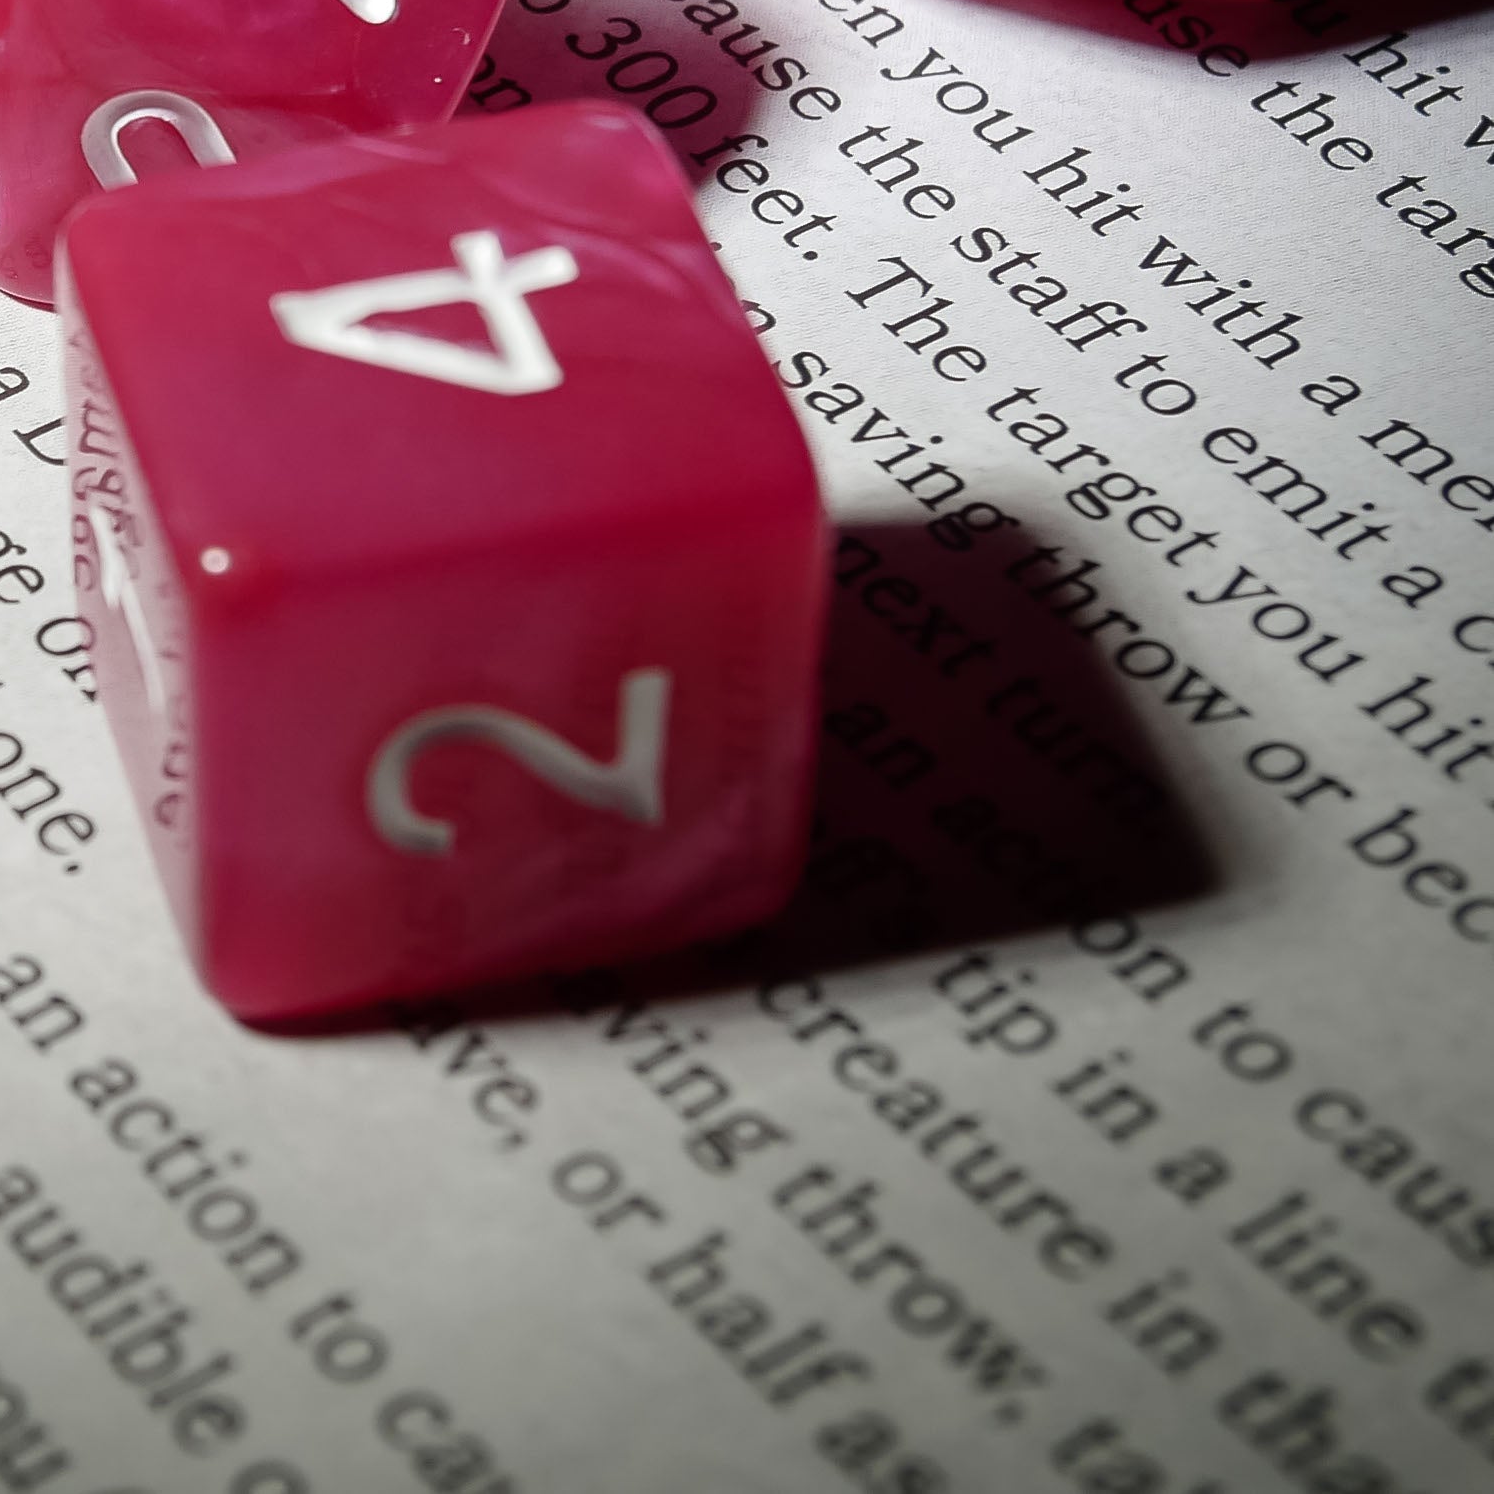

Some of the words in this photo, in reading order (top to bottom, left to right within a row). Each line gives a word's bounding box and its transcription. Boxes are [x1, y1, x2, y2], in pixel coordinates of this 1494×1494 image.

[1250, 80, 1374, 172] the
[1342, 31, 1464, 117] hit
[269, 229, 579, 396] 4
[837, 124, 956, 220] the
[951, 225, 1150, 354] staff
[1113, 351, 1198, 417] to
[1203, 425, 1393, 563] emit
[1381, 562, 1444, 609] a
[878, 46, 1035, 156] you
[1022, 145, 1143, 237] hit
[1137, 234, 1306, 371] with
[1299, 372, 1363, 418] a
[564, 16, 719, 130] 300
[691, 133, 838, 262] feet.
[845, 255, 988, 382] The
[986, 384, 1223, 569] target
[1186, 563, 1367, 686] you
[1358, 674, 1494, 783] hit
[365, 667, 672, 860] 2
[775, 348, 1021, 552] saving
[1004, 543, 1252, 728] throw
[1243, 737, 1354, 811] or
[1347, 808, 1494, 944] bec
[70, 1058, 302, 1295] action
[287, 1290, 390, 1385] to
[551, 1150, 666, 1233] or
[645, 1231, 875, 1411] half
[758, 976, 1115, 1284] creature
[1106, 1269, 1224, 1378] in
[933, 950, 1060, 1055] tip
[1052, 1049, 1160, 1145] in
[1155, 1147, 1232, 1206] a
[1228, 1191, 1427, 1365] line
[1192, 1002, 1293, 1084] to
[1294, 1087, 1494, 1271] caus
[771, 1164, 1052, 1427] throw,
